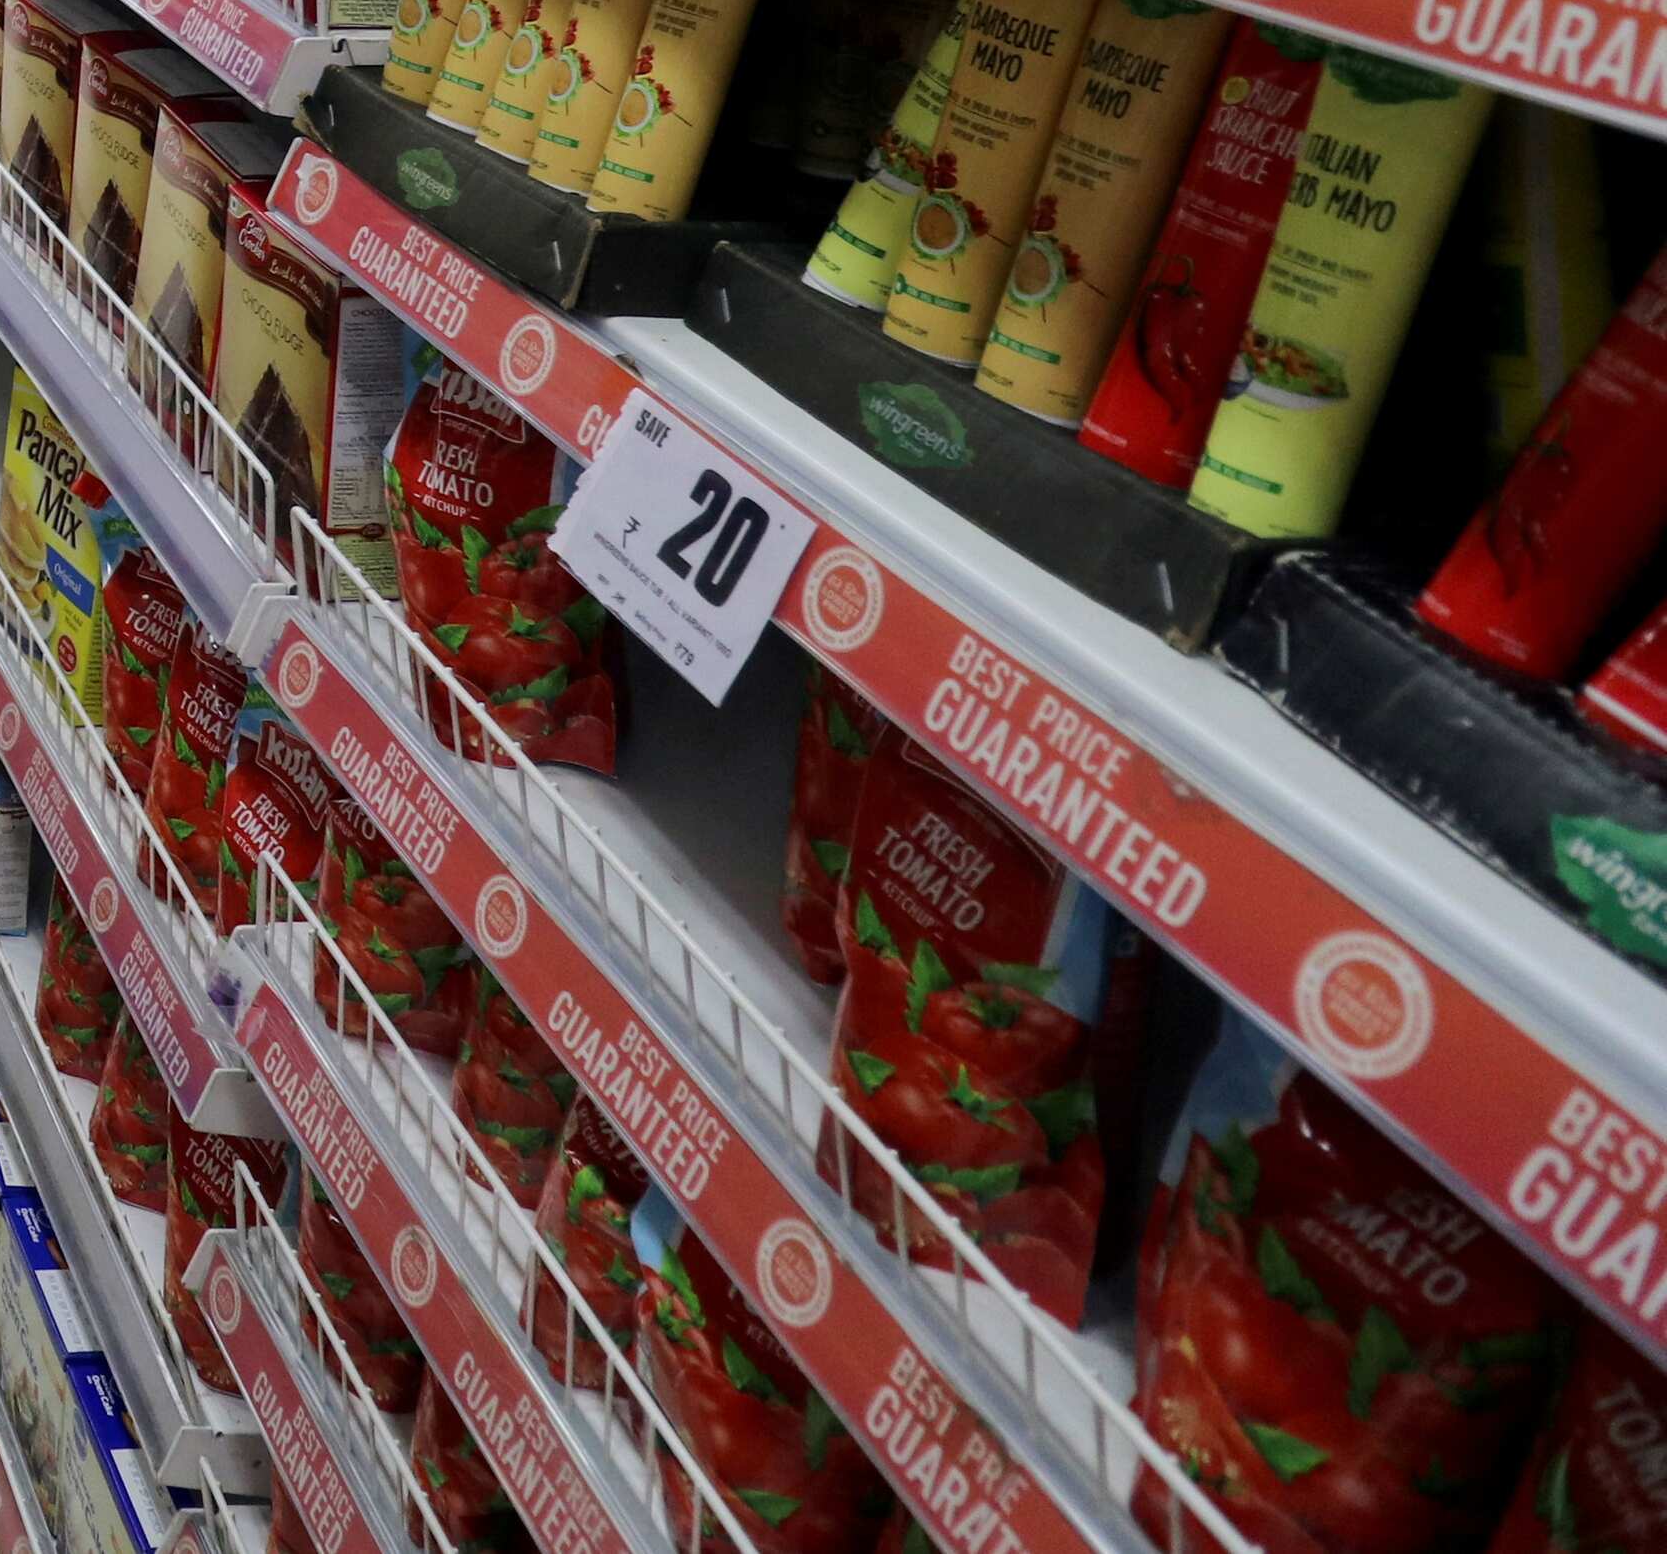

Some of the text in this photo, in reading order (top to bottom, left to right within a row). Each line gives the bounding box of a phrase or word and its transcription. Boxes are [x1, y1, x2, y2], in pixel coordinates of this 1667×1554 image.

[179, 8, 264, 86] GUARANTEED
[969, 1, 1060, 60] BARBEQUE
[969, 37, 1025, 85] MAYO
[1079, 36, 1171, 97] BARBEQUE
[1079, 78, 1135, 122] MAYO
[89, 120, 141, 171] CHOCO FUDGE
[399, 158, 458, 204] wingreens
[1207, 142, 1272, 185] SAUCE
[1324, 184, 1397, 233] MAYO
[348, 223, 469, 341] GUARANTEED
[242, 289, 304, 356] CHOCO FUDGE
[15, 409, 90, 486] Panca
[435, 440, 480, 475] RESH
[634, 408, 672, 449] SAVE
[868, 392, 964, 464] wingreens
[34, 475, 84, 549] Mix
[623, 515, 642, 549] ₹
[656, 468, 771, 608] 20
[52, 562, 82, 597] Original
[948, 632, 1133, 792] BEST PRICE
[264, 737, 329, 813] Kissan
[326, 724, 449, 878] GUARANTEED
[921, 677, 1210, 932] GUARANTEED
[230, 802, 286, 865] TOMATO
[249, 793, 292, 839] FRESH
[873, 830, 988, 933] TOMATO
[906, 810, 997, 902] FRESH
[877, 879, 939, 930] KETCHUP
[259, 1039, 366, 1211] GUARANTEED
[546, 988, 714, 1205] GUARANTEED
[663, 1076, 733, 1166] PRICE
[889, 1348, 957, 1437] BEST
